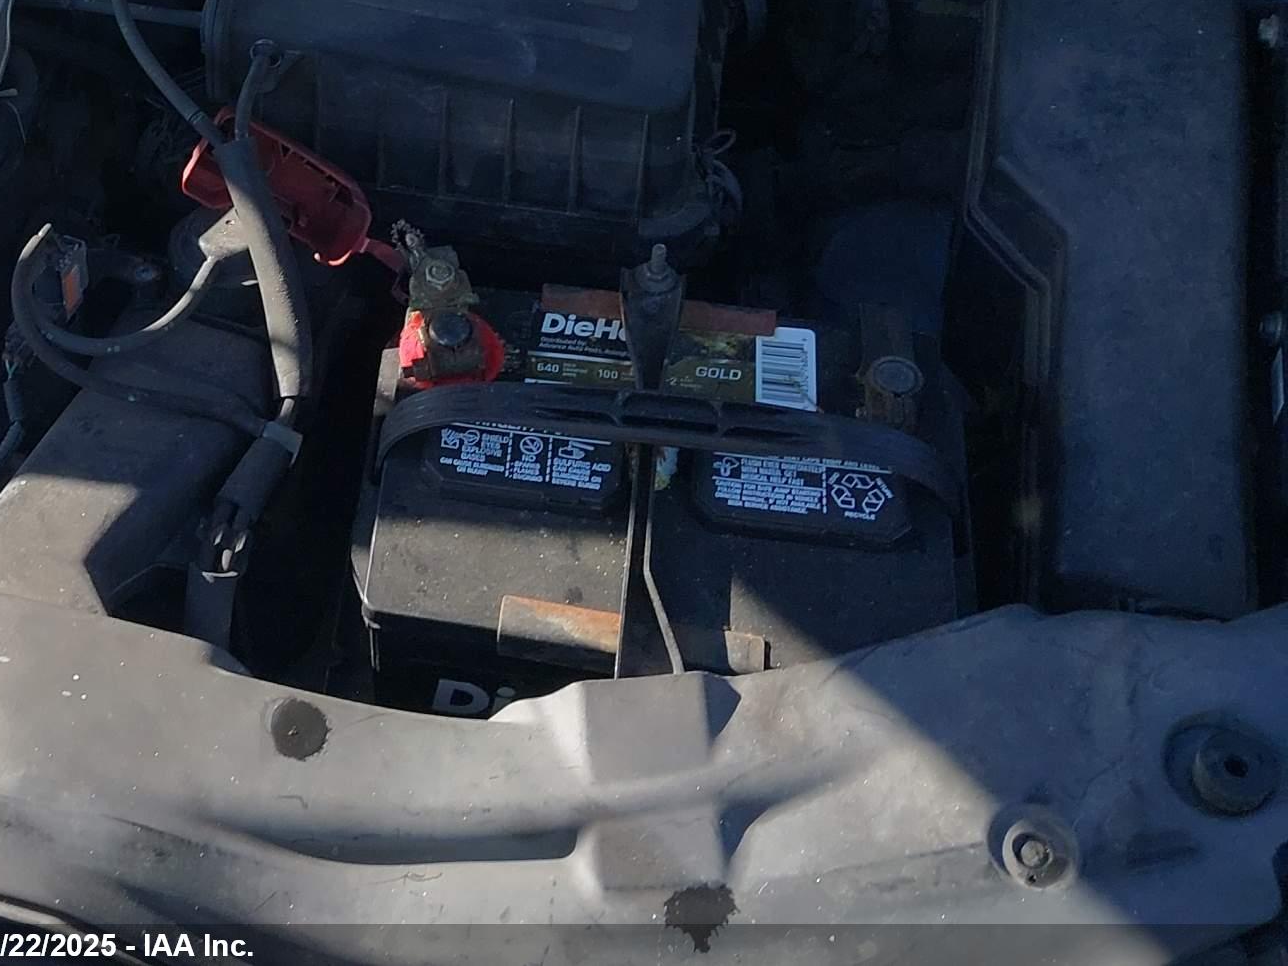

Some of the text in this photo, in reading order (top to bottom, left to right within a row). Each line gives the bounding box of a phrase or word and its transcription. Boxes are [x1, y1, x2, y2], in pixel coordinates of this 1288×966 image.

[597, 368, 619, 380] 100
[696, 366, 742, 381] GOLD
[522, 454, 537, 463] NO
[591, 462, 612, 472] ACID
[844, 510, 876, 521] RECYCLE
